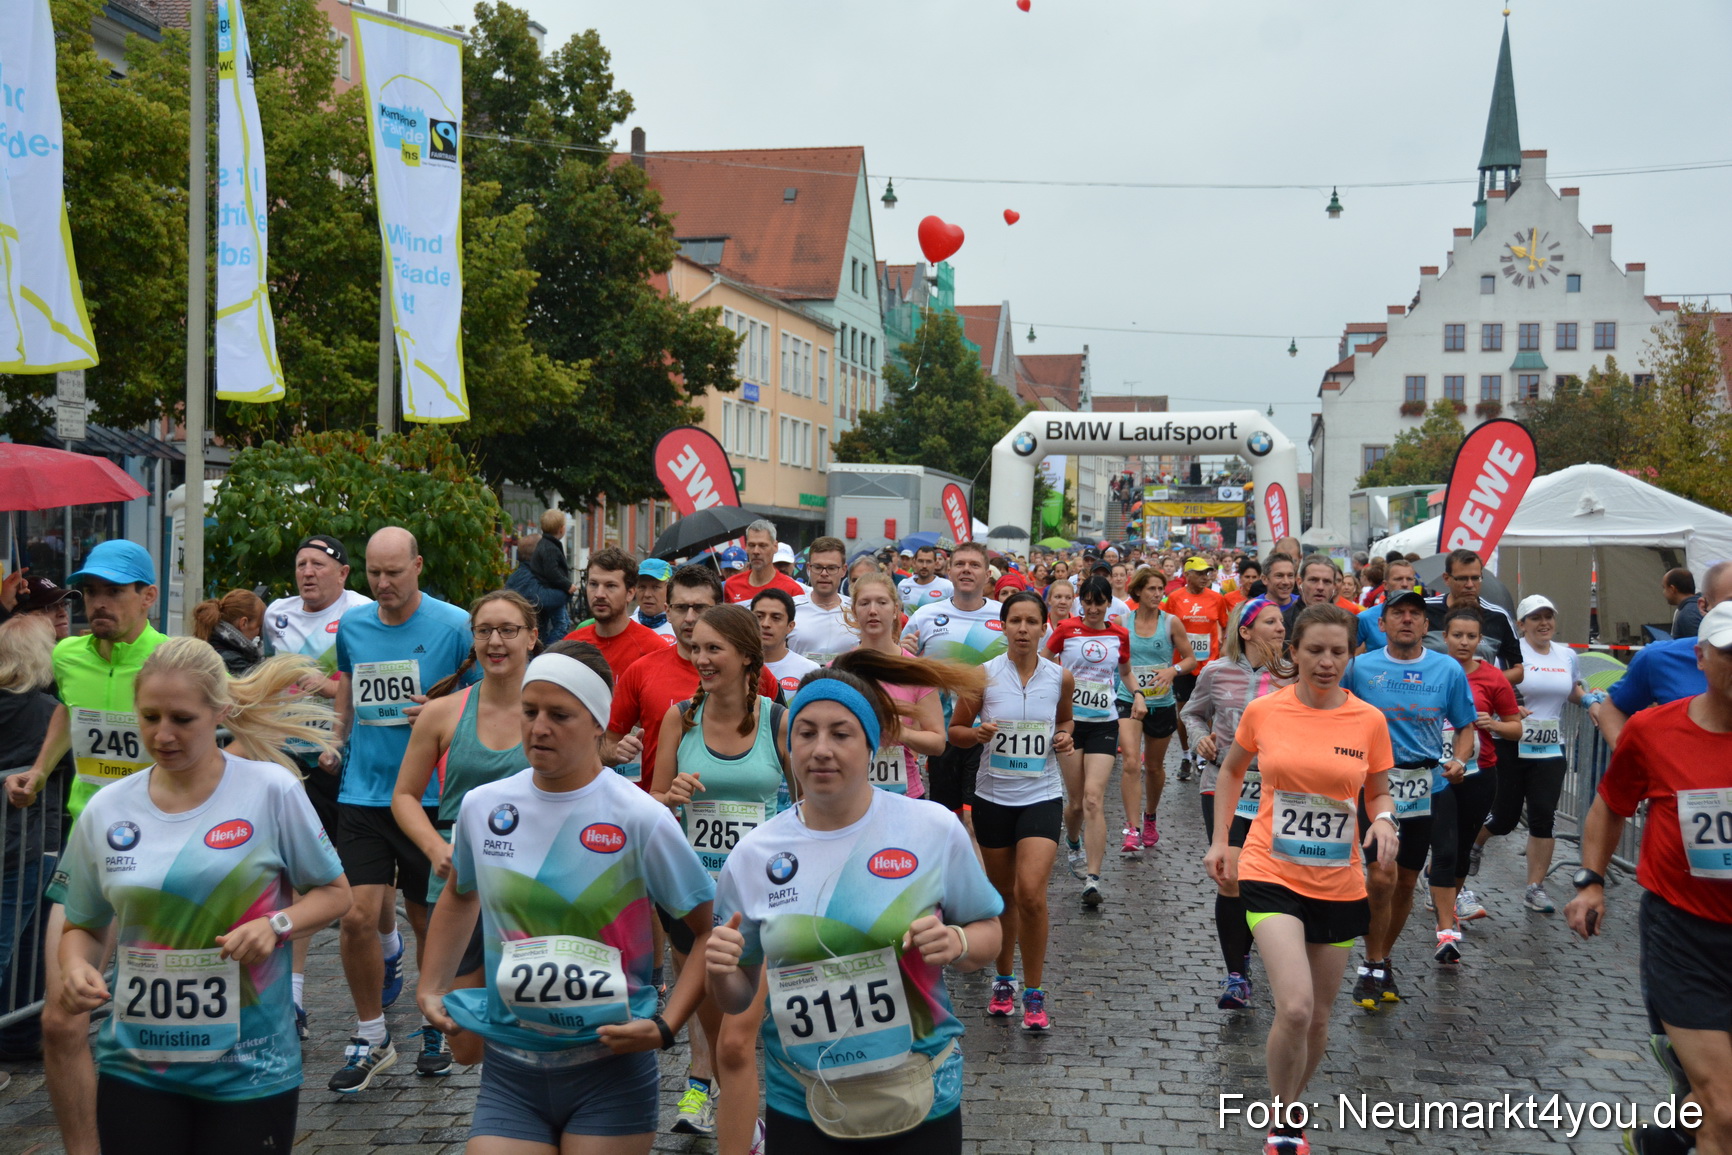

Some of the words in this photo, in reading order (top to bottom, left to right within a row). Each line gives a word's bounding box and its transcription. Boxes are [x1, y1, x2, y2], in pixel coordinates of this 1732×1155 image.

[1046, 420, 1112, 441] BMW
[1119, 420, 1238, 445] Laufsport
[1447, 439, 1524, 552] REWE
[1183, 505, 1206, 514] ZIEL
[360, 676, 415, 702] 2069
[1386, 679, 1444, 693] firmenlauf
[1073, 689, 1109, 708] 2048
[378, 707, 398, 717] Bubi
[1524, 728, 1558, 743] 2409
[88, 728, 139, 759] 246
[996, 733, 1045, 755] 2110
[1334, 746, 1364, 760] THULE
[98, 762, 133, 776] Tomas
[1009, 760, 1028, 769] Nina
[720, 803, 758, 814] BOCK
[1281, 809, 1349, 839] 2437
[210, 826, 248, 842] Hervis
[586, 829, 622, 845] Hervis
[483, 839, 515, 851] PARTL
[1299, 844, 1326, 856] Anita
[106, 856, 137, 866] PARTL
[483, 849, 514, 858] Neumarkt
[106, 865, 136, 873] Neumarkt
[875, 856, 913, 871] Hervis
[768, 887, 799, 902] PARTL
[768, 896, 799, 909] Neumarkt
[555, 939, 610, 963] BOCK
[165, 953, 227, 968] BOCK
[822, 953, 886, 977] BOCK
[511, 962, 615, 1003] 2282
[779, 976, 818, 988] NeuerMarkt
[127, 976, 228, 1019] 2053
[786, 979, 896, 1038] 3115
[549, 1012, 585, 1027] Nina
[139, 1029, 211, 1047] Christina
[818, 1045, 867, 1065] Anna
